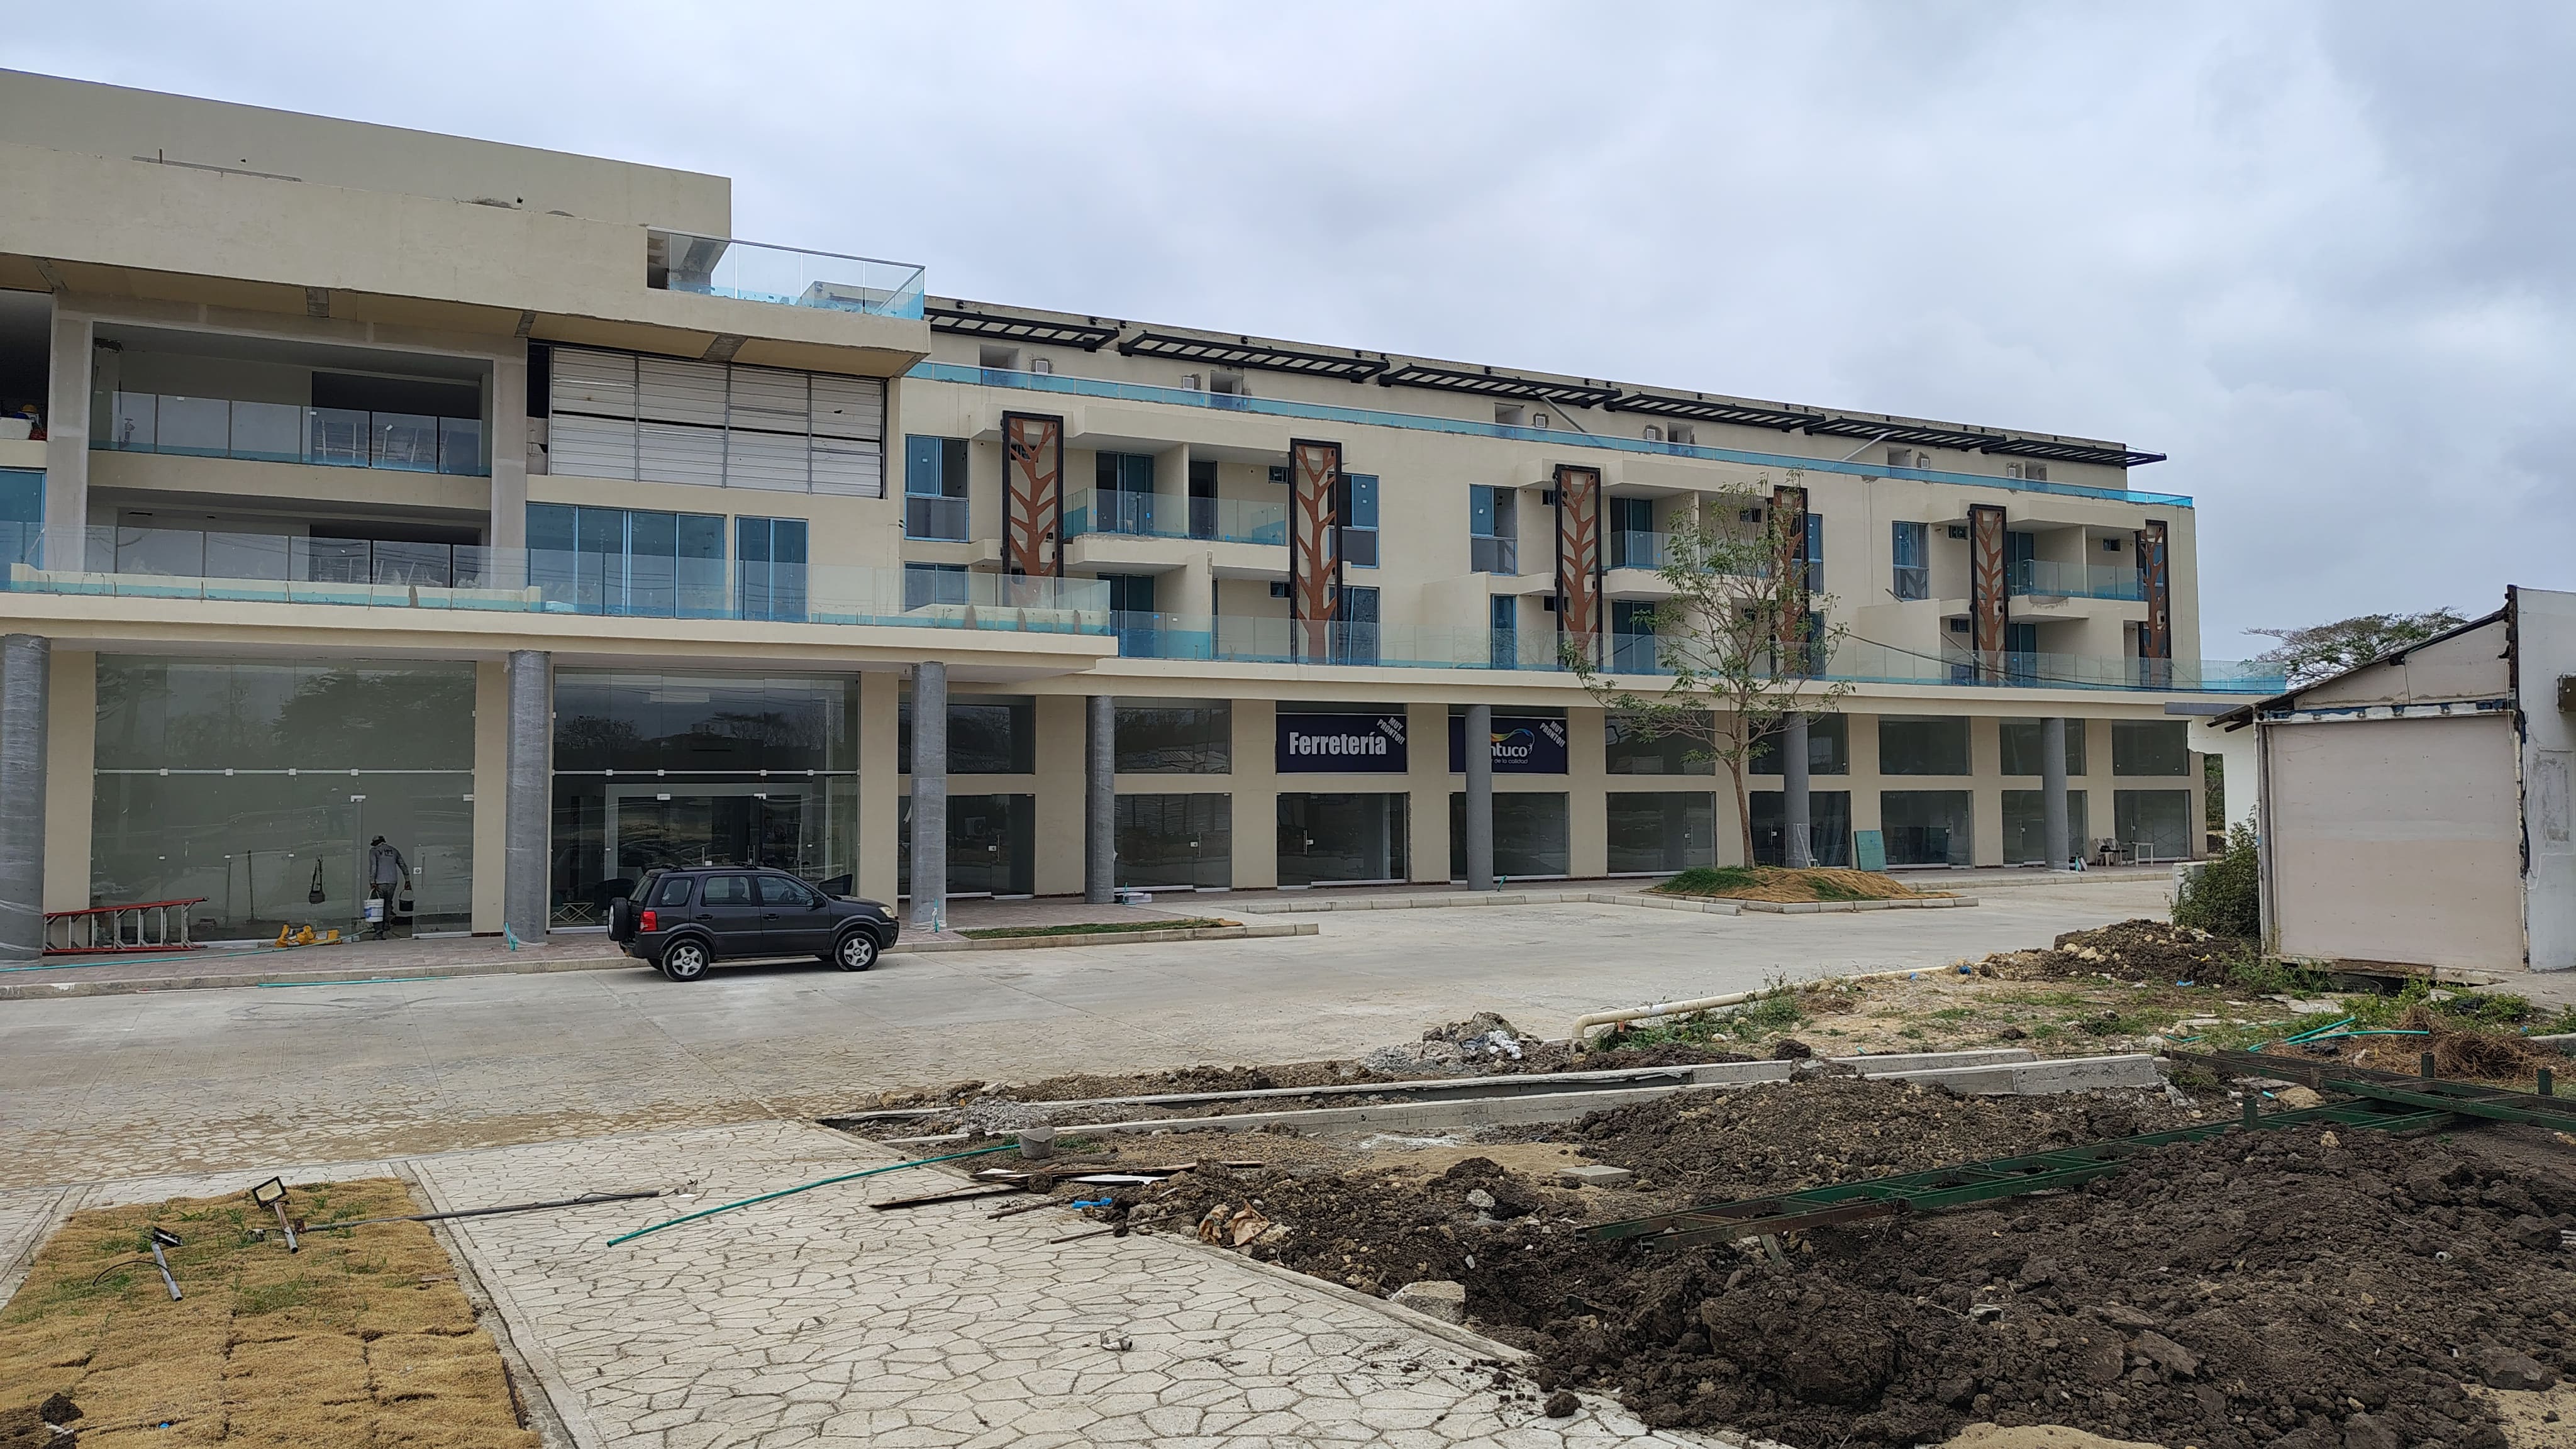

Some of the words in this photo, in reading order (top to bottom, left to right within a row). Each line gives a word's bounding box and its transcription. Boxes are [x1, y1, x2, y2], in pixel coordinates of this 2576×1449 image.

[1388, 716, 1404, 731] MUY
[1550, 720, 1564, 735] MUY
[1289, 731, 1387, 755] Ferretería
